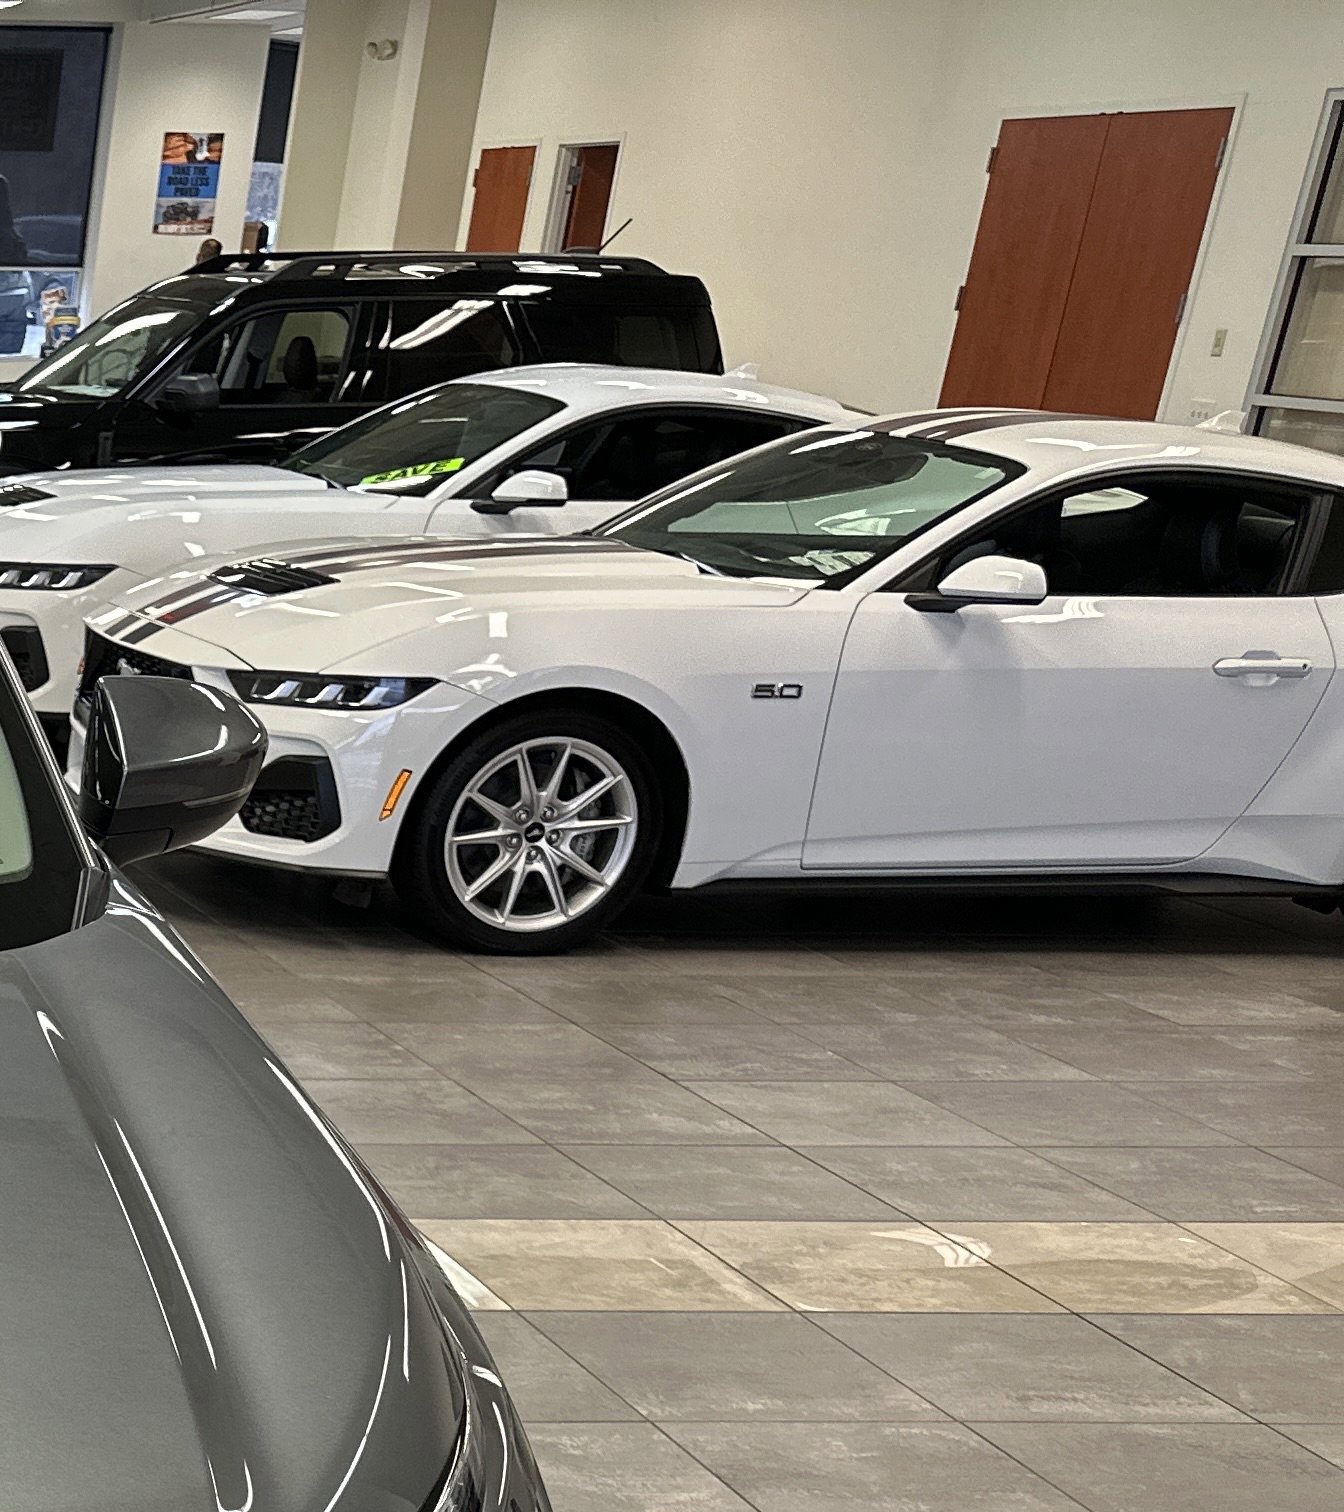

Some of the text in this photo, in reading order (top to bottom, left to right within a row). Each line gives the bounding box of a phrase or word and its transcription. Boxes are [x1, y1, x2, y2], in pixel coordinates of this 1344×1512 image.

[167, 176, 210, 186] ROAD LESS
[370, 459, 451, 484] SAVE
[752, 683, 804, 699] 5.0
